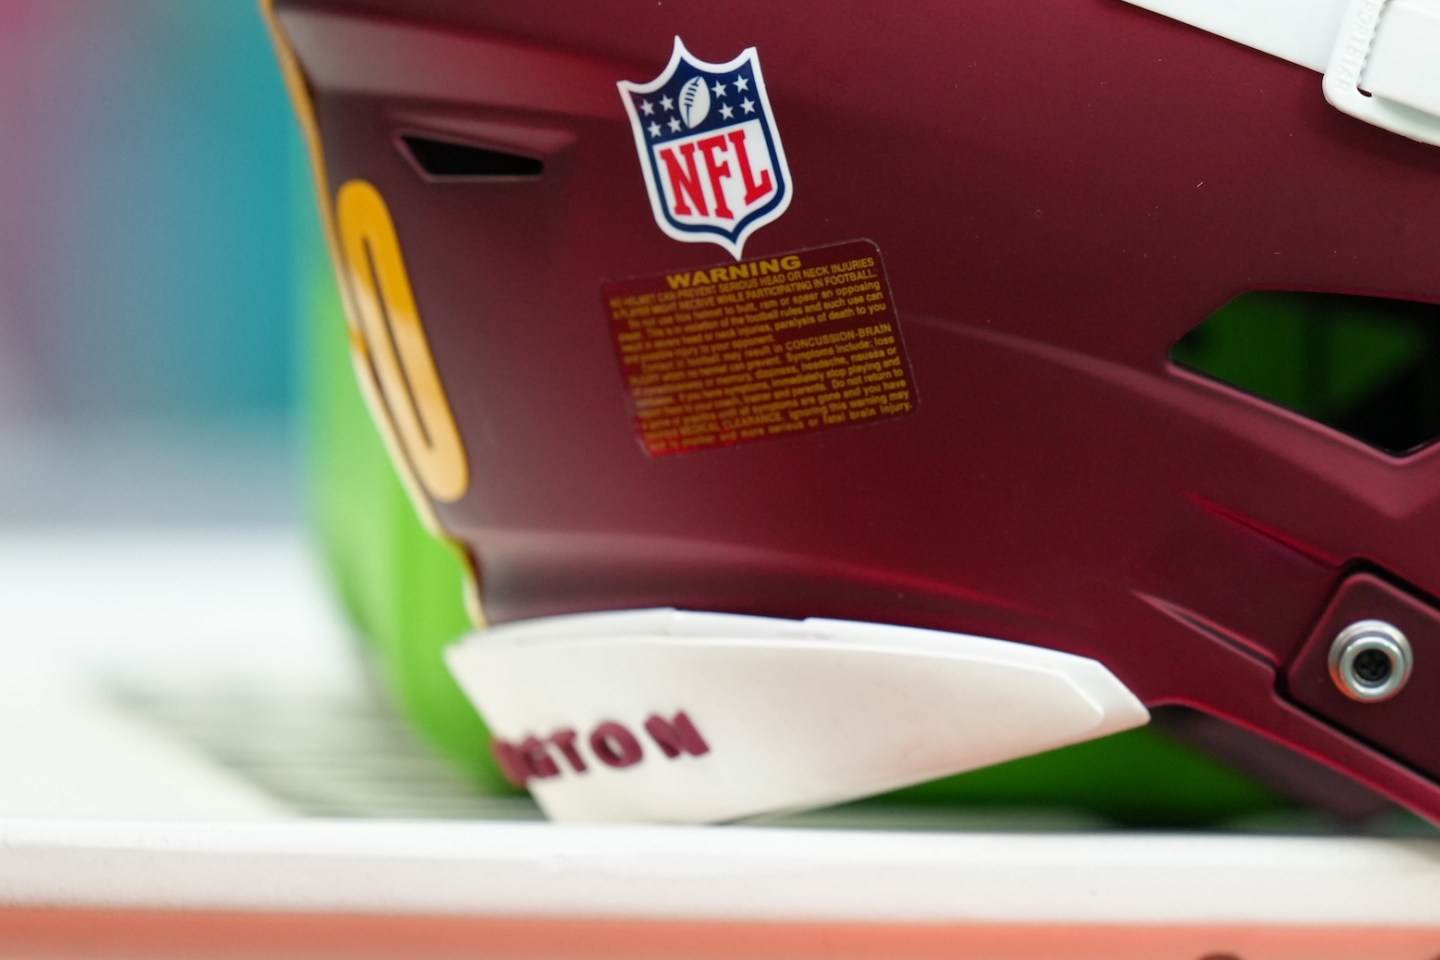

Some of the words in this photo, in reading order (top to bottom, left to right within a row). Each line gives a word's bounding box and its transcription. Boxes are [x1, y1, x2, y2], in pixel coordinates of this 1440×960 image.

[658, 128, 774, 221] NFL
[667, 256, 800, 288] WARNING
[760, 274, 785, 285] HEAD
[787, 271, 801, 281] OR
[803, 266, 829, 278] NECK
[831, 257, 874, 273] INJURIES
[813, 278, 824, 288] IN
[821, 290, 833, 298] an
[836, 281, 880, 296] opposing
[847, 296, 864, 305] use
[866, 292, 883, 301] can
[856, 307, 866, 315] to
[868, 303, 886, 315] you
[786, 324, 891, 350] CONCUSSION-BRAIN
[887, 347, 897, 355] or
[883, 357, 900, 368] and
[831, 379, 845, 389] Do
[893, 369, 903, 377] to
[863, 385, 881, 396] you
